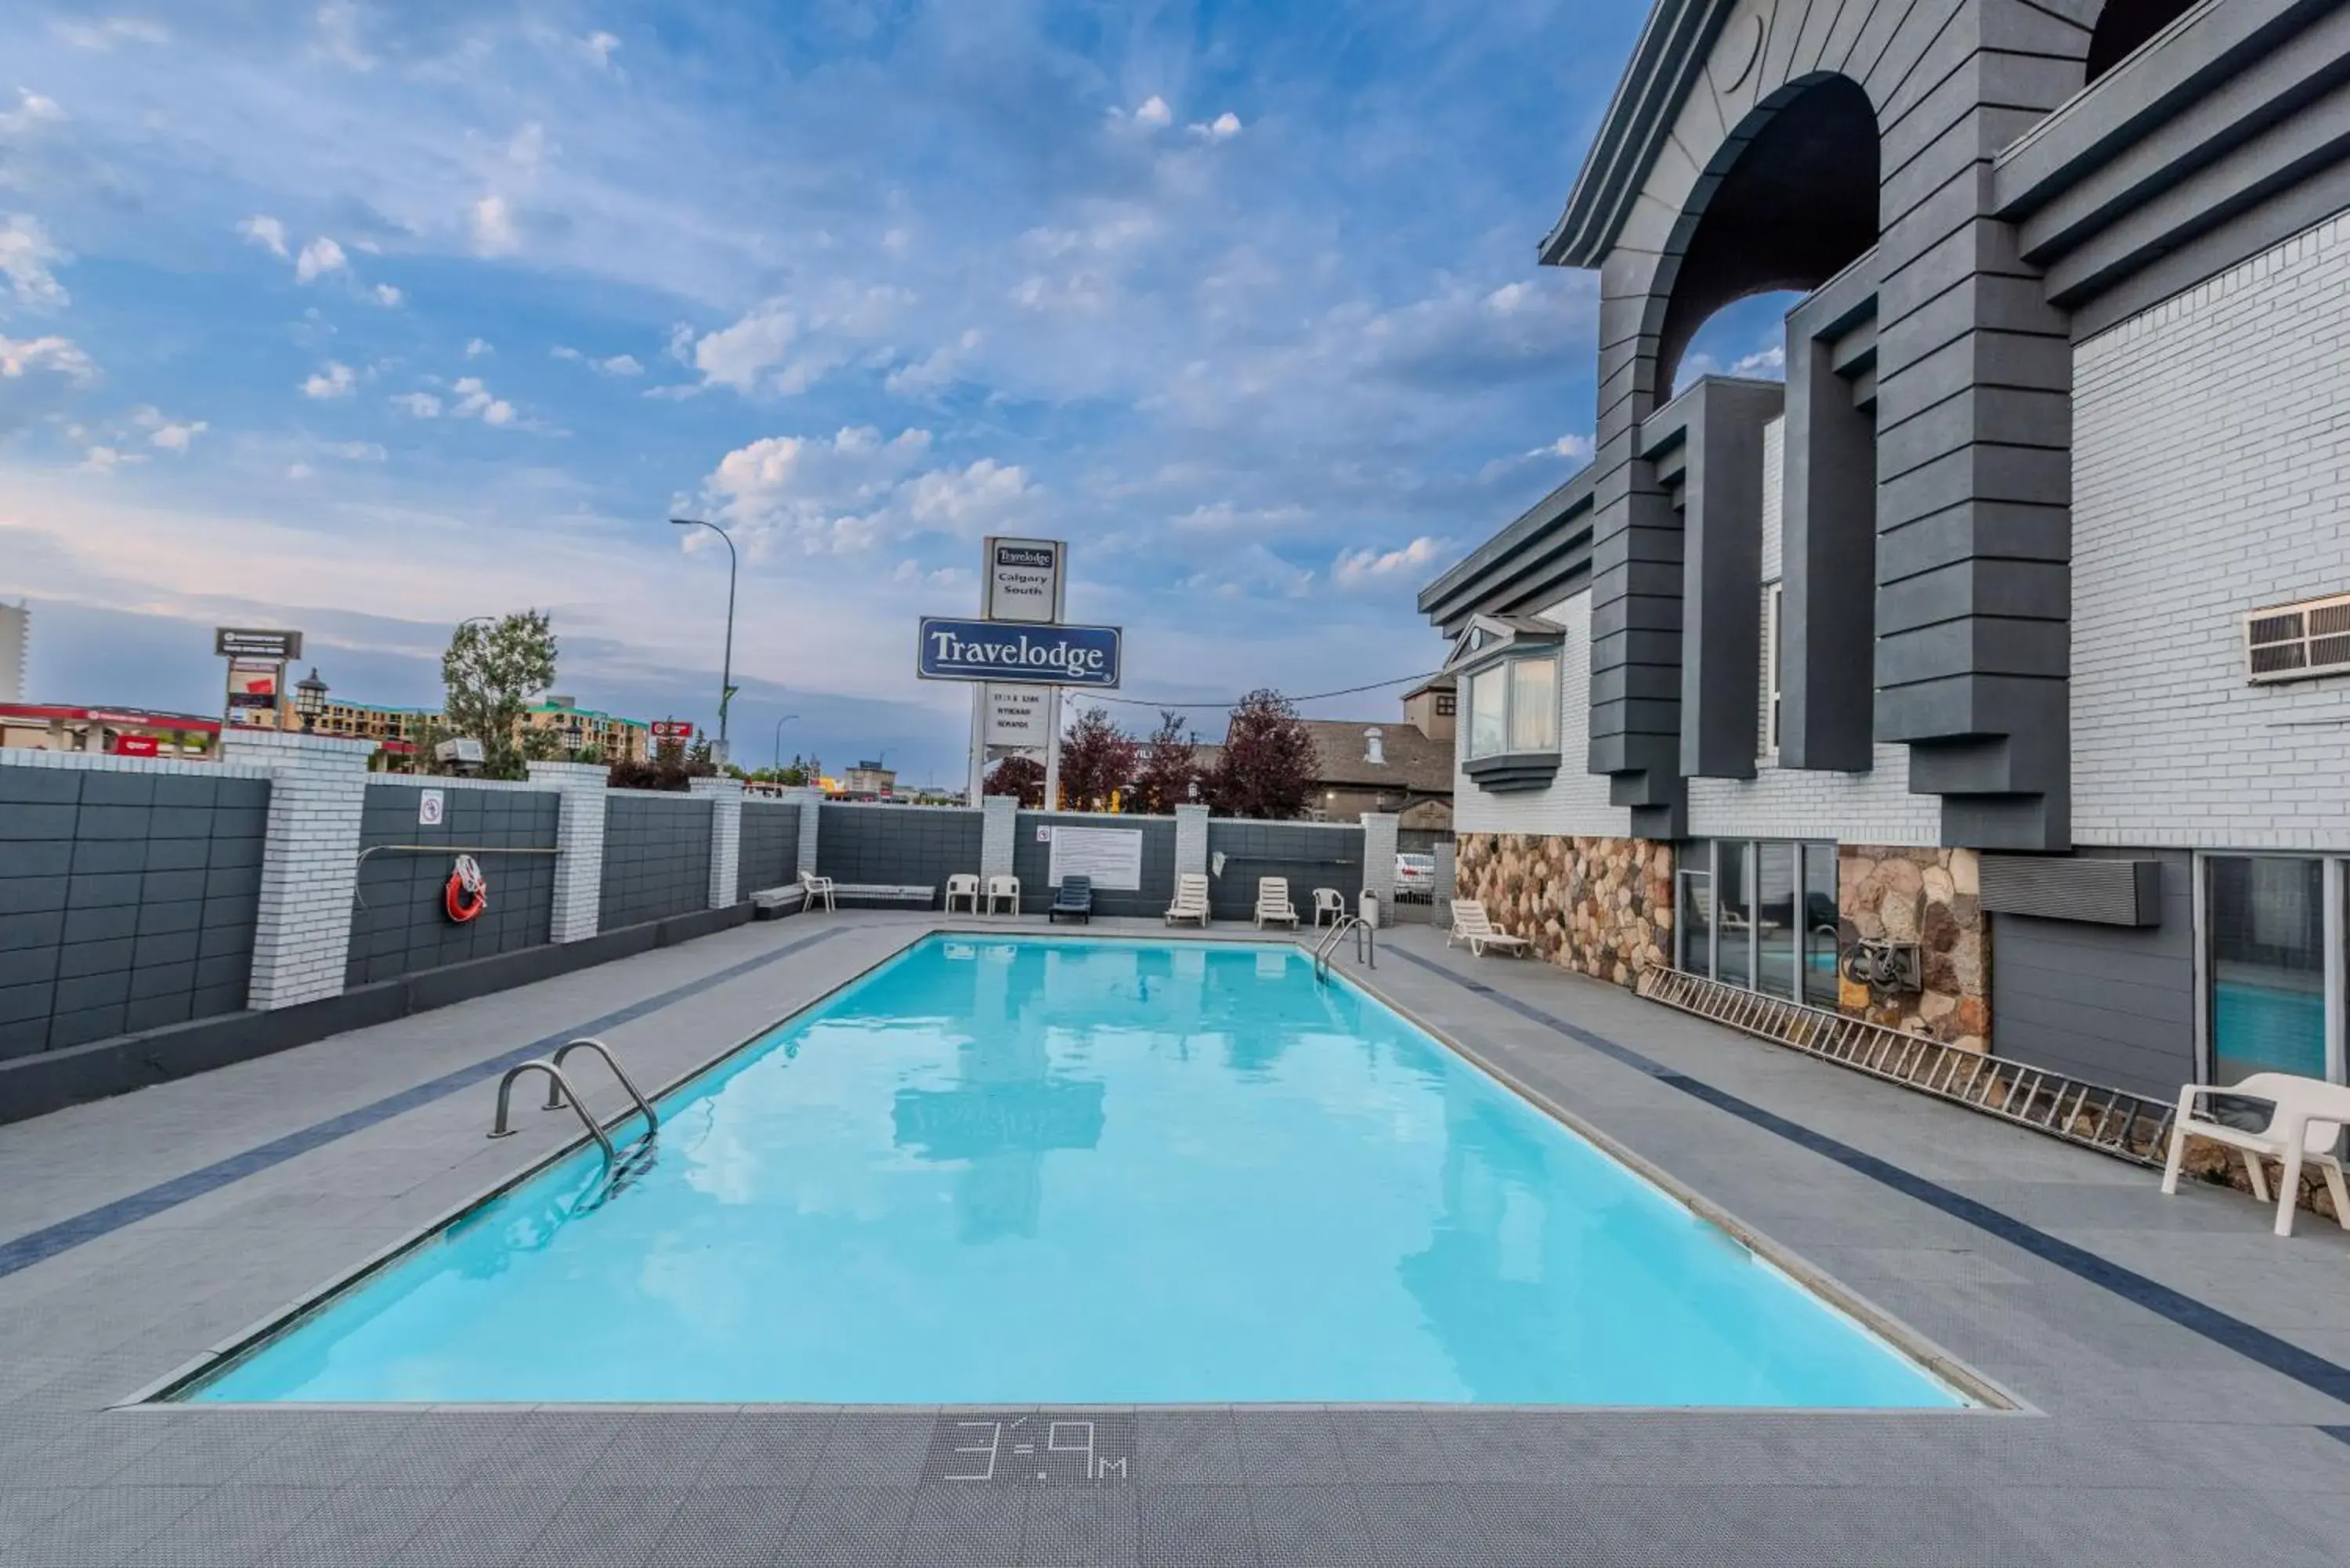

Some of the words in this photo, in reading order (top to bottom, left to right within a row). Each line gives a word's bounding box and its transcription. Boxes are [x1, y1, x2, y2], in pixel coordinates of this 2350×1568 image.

[1000, 550, 1050, 566] Travelodge
[999, 573, 1047, 584] Calgary
[1004, 585, 1043, 595] South
[931, 631, 1104, 677] Travelodge
